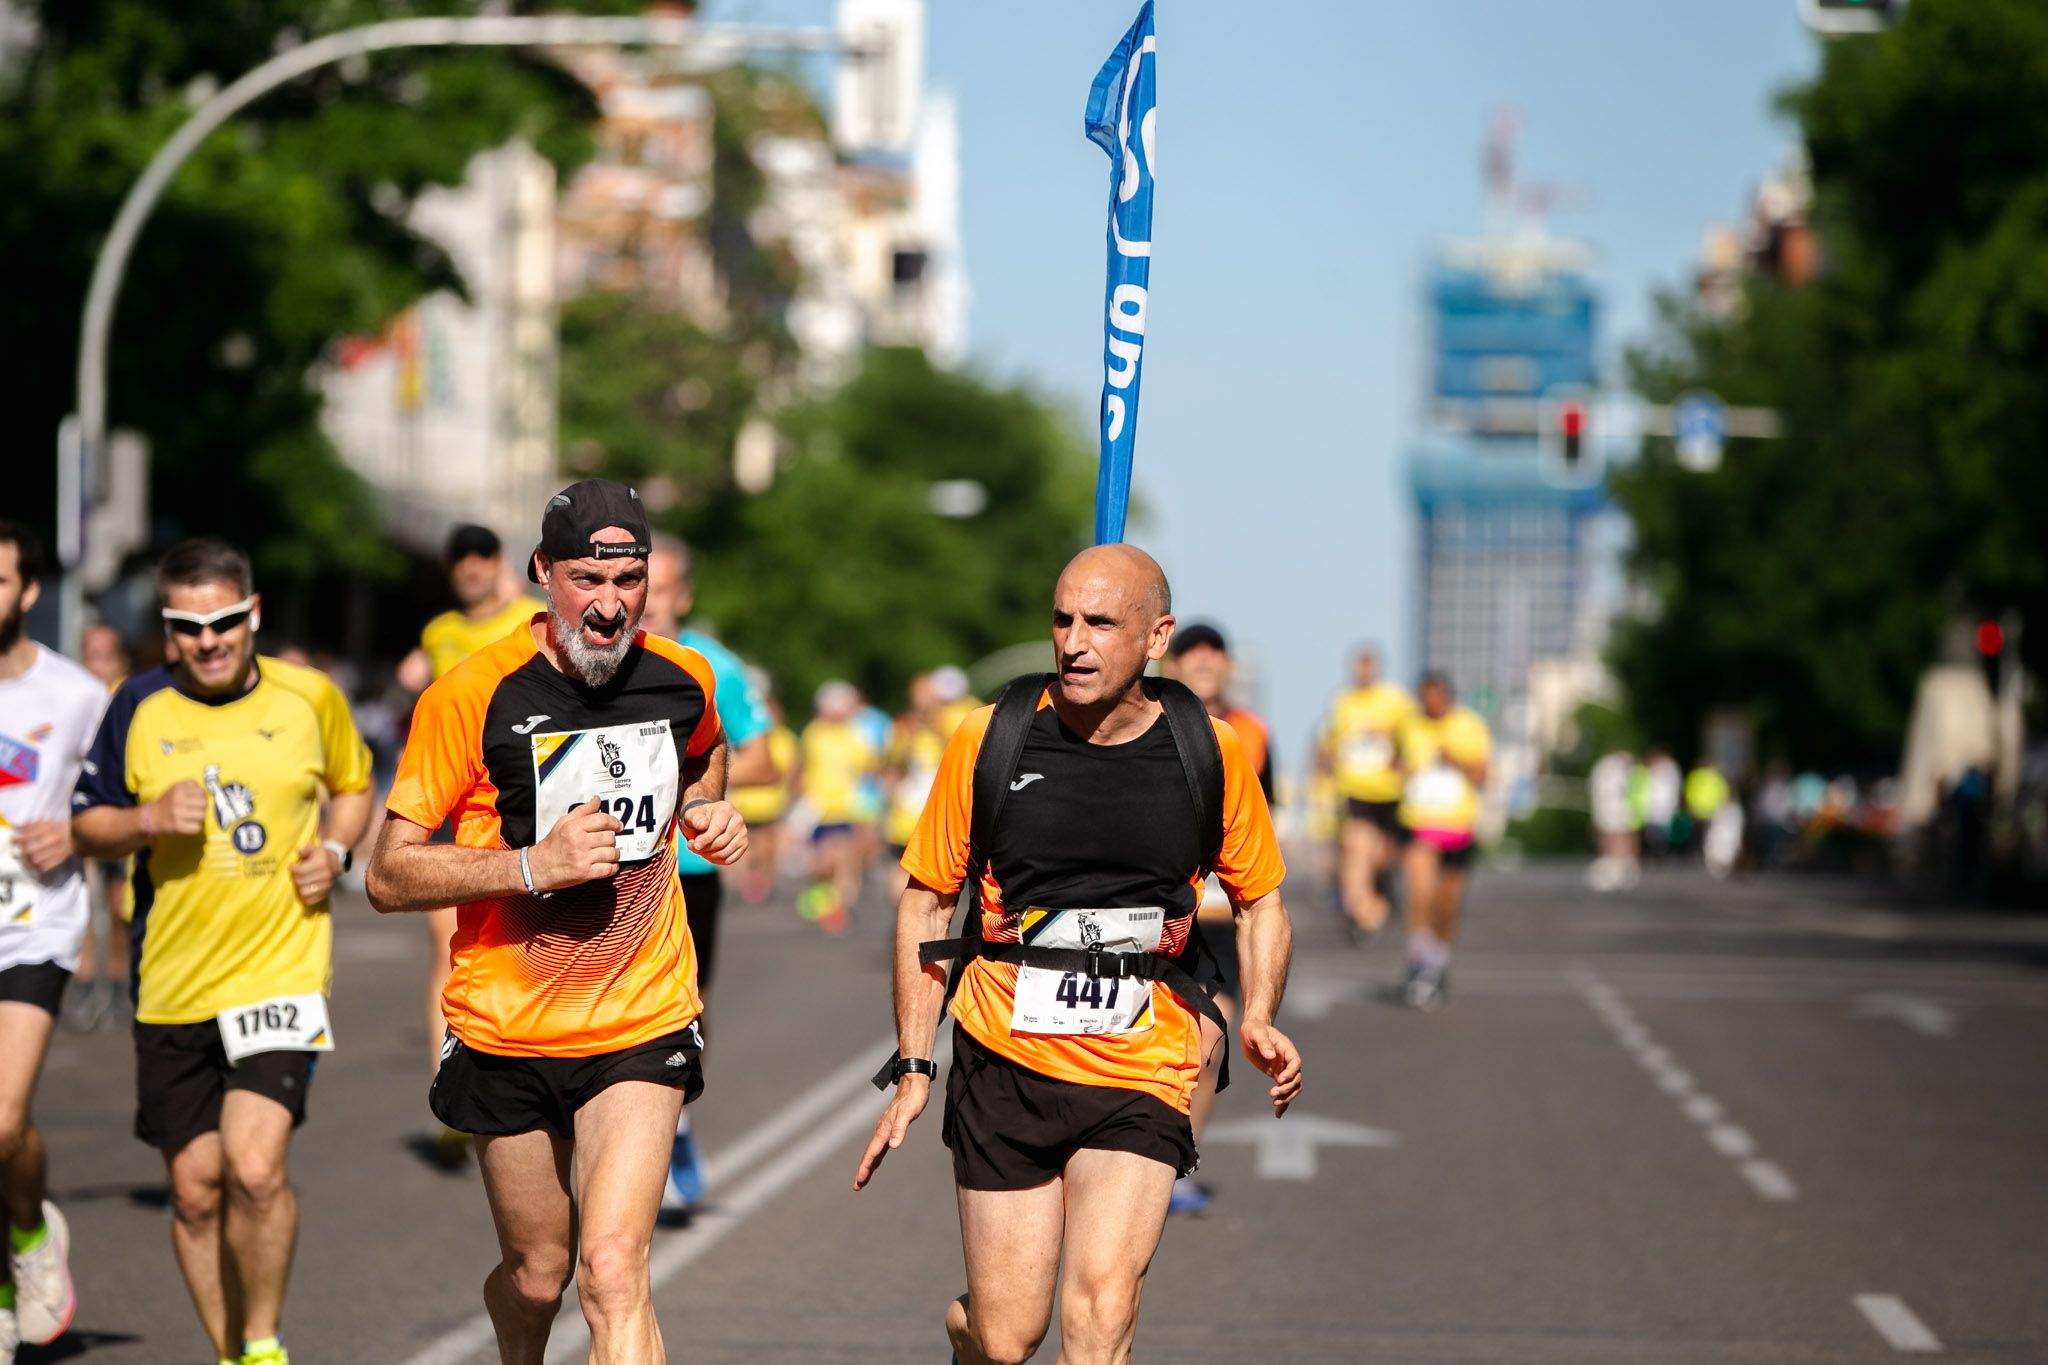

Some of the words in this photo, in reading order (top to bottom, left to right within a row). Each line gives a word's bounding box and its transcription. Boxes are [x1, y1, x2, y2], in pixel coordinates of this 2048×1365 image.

[599, 546, 636, 555] Kalenji
[612, 763, 624, 775] 13
[568, 795, 657, 836] 24
[1056, 972, 1119, 1009] 447
[234, 1004, 300, 1037] 1762
